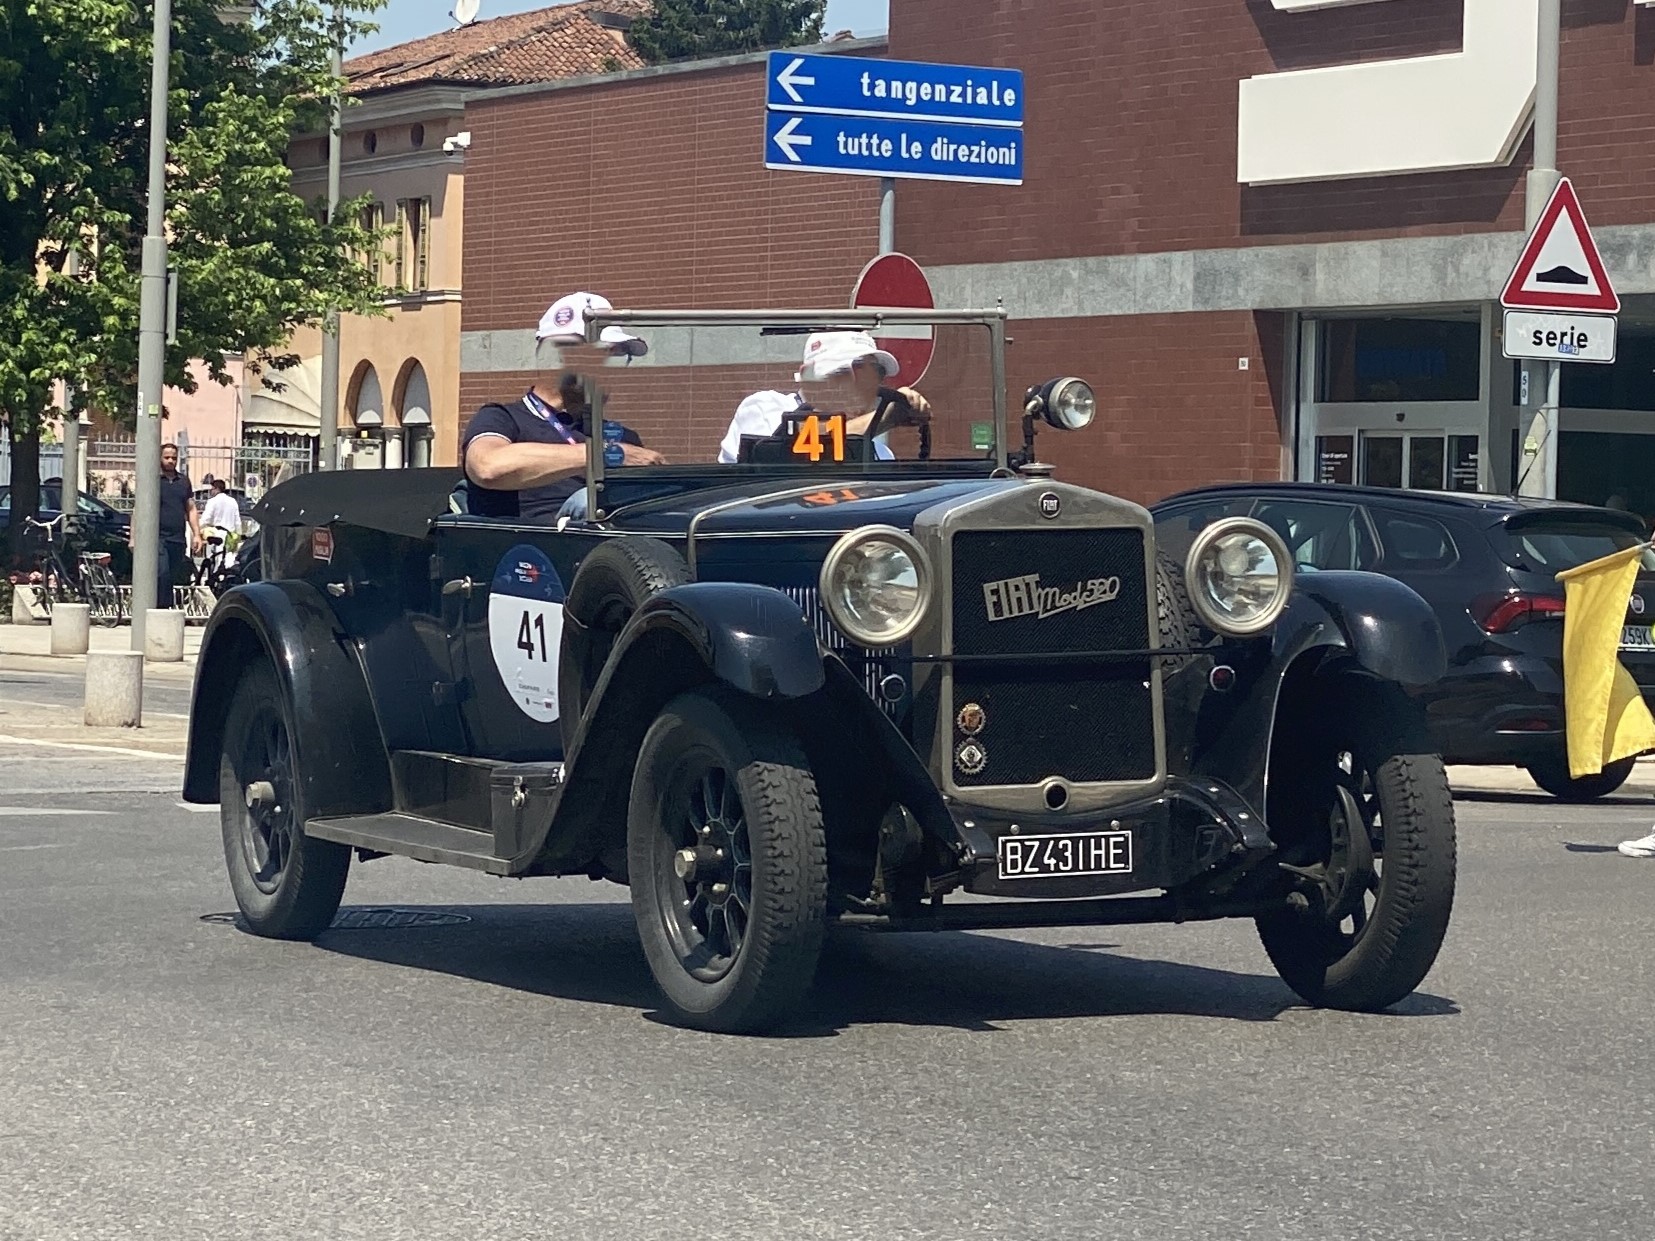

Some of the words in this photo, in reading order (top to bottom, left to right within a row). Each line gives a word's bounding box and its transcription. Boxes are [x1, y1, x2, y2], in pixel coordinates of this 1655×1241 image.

[860, 71, 1016, 107] tangenziale
[837, 131, 893, 157] tutte
[900, 133, 922, 159] le
[930, 137, 1016, 165] direzioni
[1532, 326, 1588, 349] serie
[792, 415, 844, 462] 41
[983, 573, 1040, 622] FIAT
[517, 610, 547, 662] 41
[1005, 836, 1125, 874] BZ431HE
